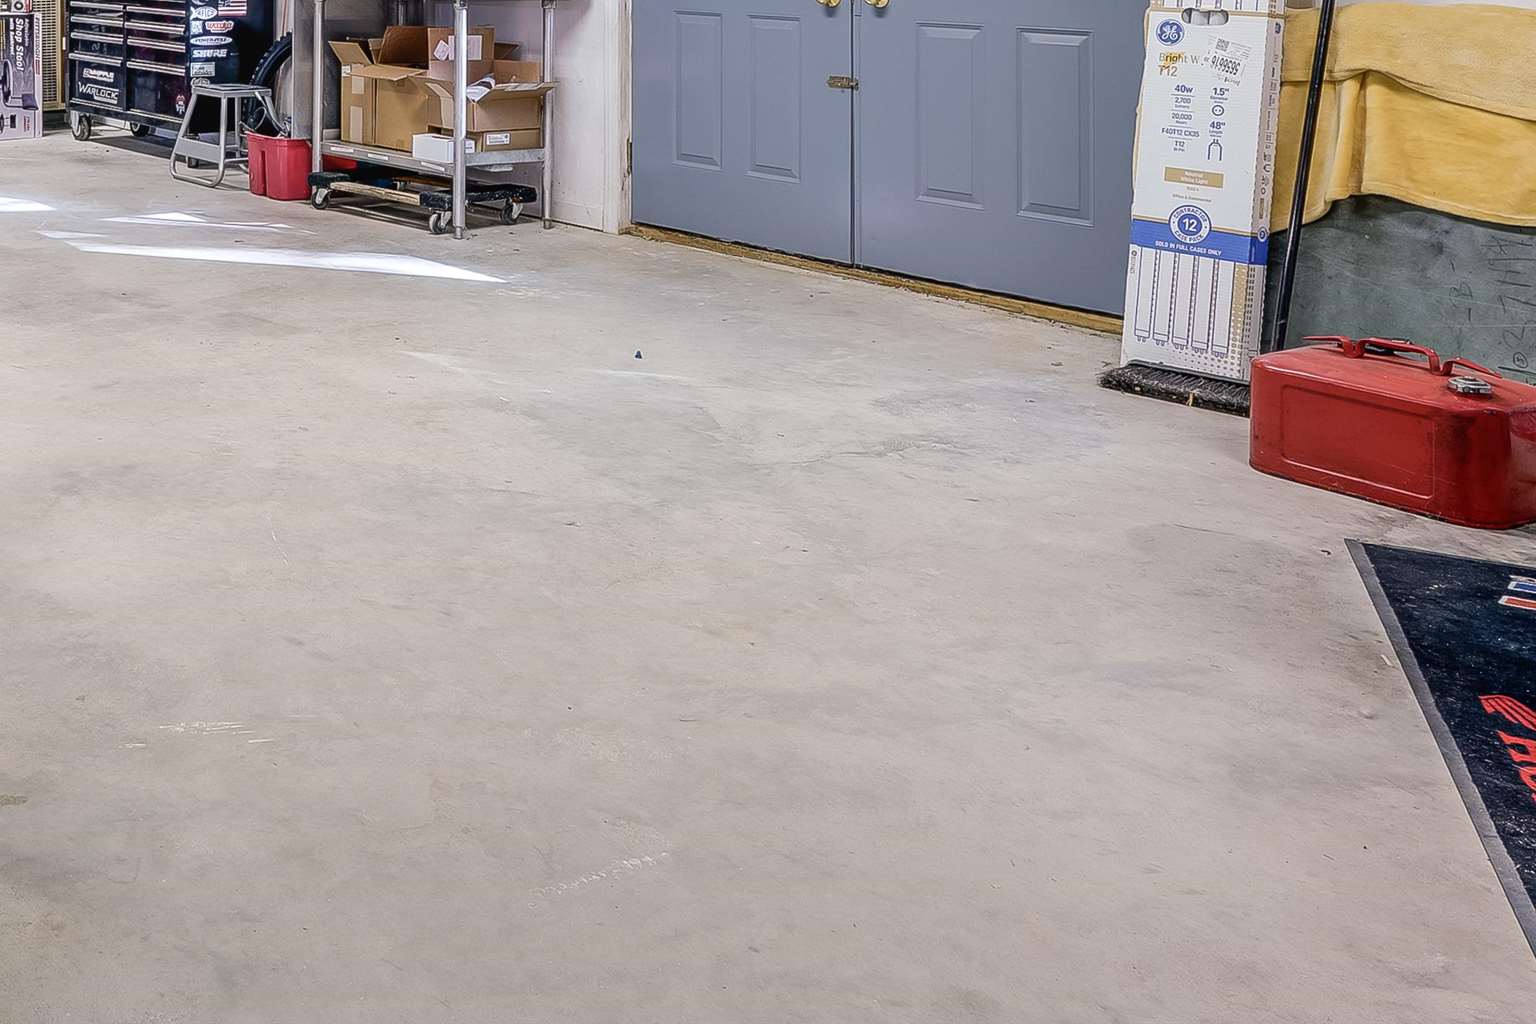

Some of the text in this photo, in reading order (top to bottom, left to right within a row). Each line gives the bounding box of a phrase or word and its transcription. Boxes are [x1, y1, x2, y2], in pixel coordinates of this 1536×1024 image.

[15, 17, 24, 71] Shop Stool
[192, 48, 228, 58] SHURE
[1159, 52, 1188, 64] Bright
[1158, 64, 1178, 77] T12
[78, 82, 119, 100] WARLOCK
[1174, 84, 1194, 94] 40w
[1174, 97, 1192, 105] 2,700
[1171, 113, 1193, 121] 20,000
[1161, 128, 1183, 136] F40T12
[1175, 140, 1185, 148] T12
[1173, 207, 1208, 222] CONTRACTOR
[1182, 218, 1197, 232] 12
[1175, 230, 1204, 243] CASE PACK
[1155, 240, 1168, 248] SOLD
[1176, 243, 1188, 251] FULL
[1189, 246, 1206, 254] CASES
[1207, 249, 1222, 257] ONLY
